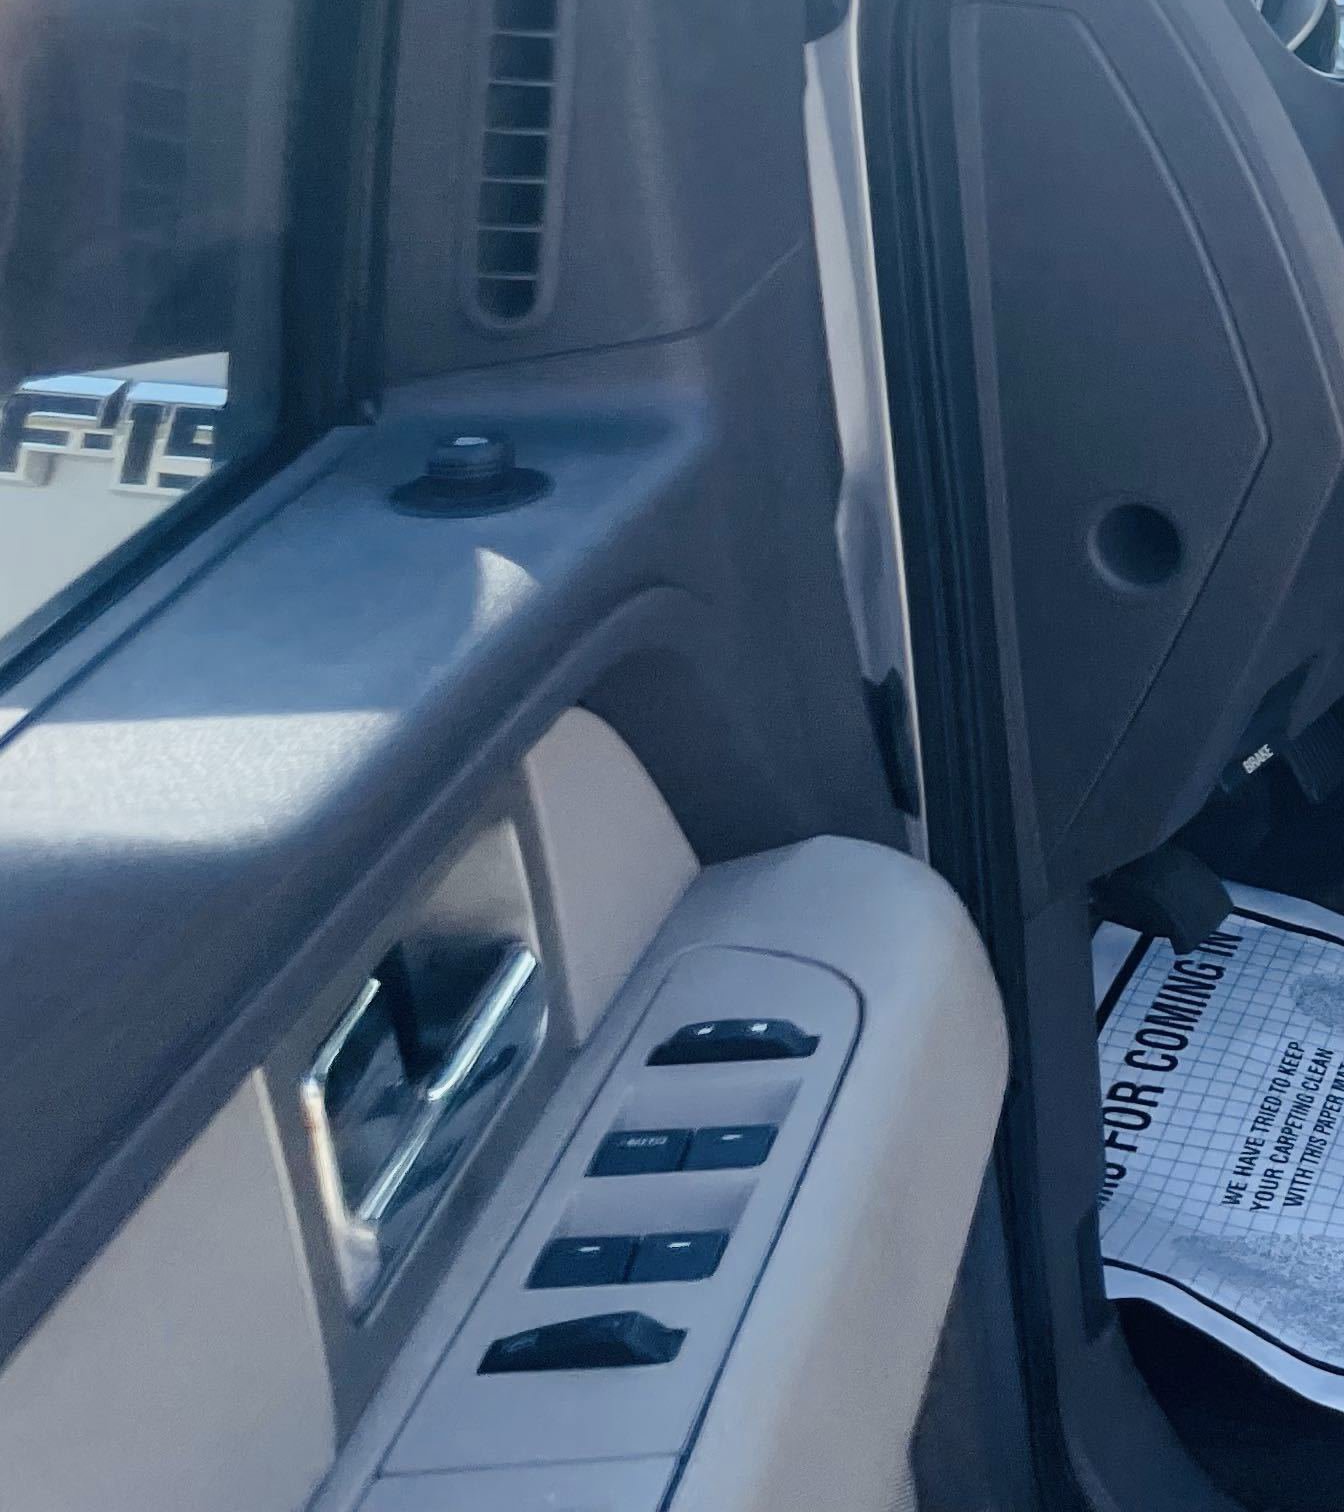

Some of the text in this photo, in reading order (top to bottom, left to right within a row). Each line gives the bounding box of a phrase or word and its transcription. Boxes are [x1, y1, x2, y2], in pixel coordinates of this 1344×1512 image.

[1242, 743, 1274, 774] BRAKE
[1124, 959, 1227, 1073] COMING
[1102, 1081, 1165, 1153] FOR
[1221, 1041, 1305, 1205] WE HAVE TRIED TO KEEP
[1250, 1048, 1335, 1212] YOUR CARPETING CLEAN
[1313, 1095, 1344, 1136] PAPER
[1300, 1136, 1328, 1165] THIS
[1283, 1167, 1314, 1207] WITH
